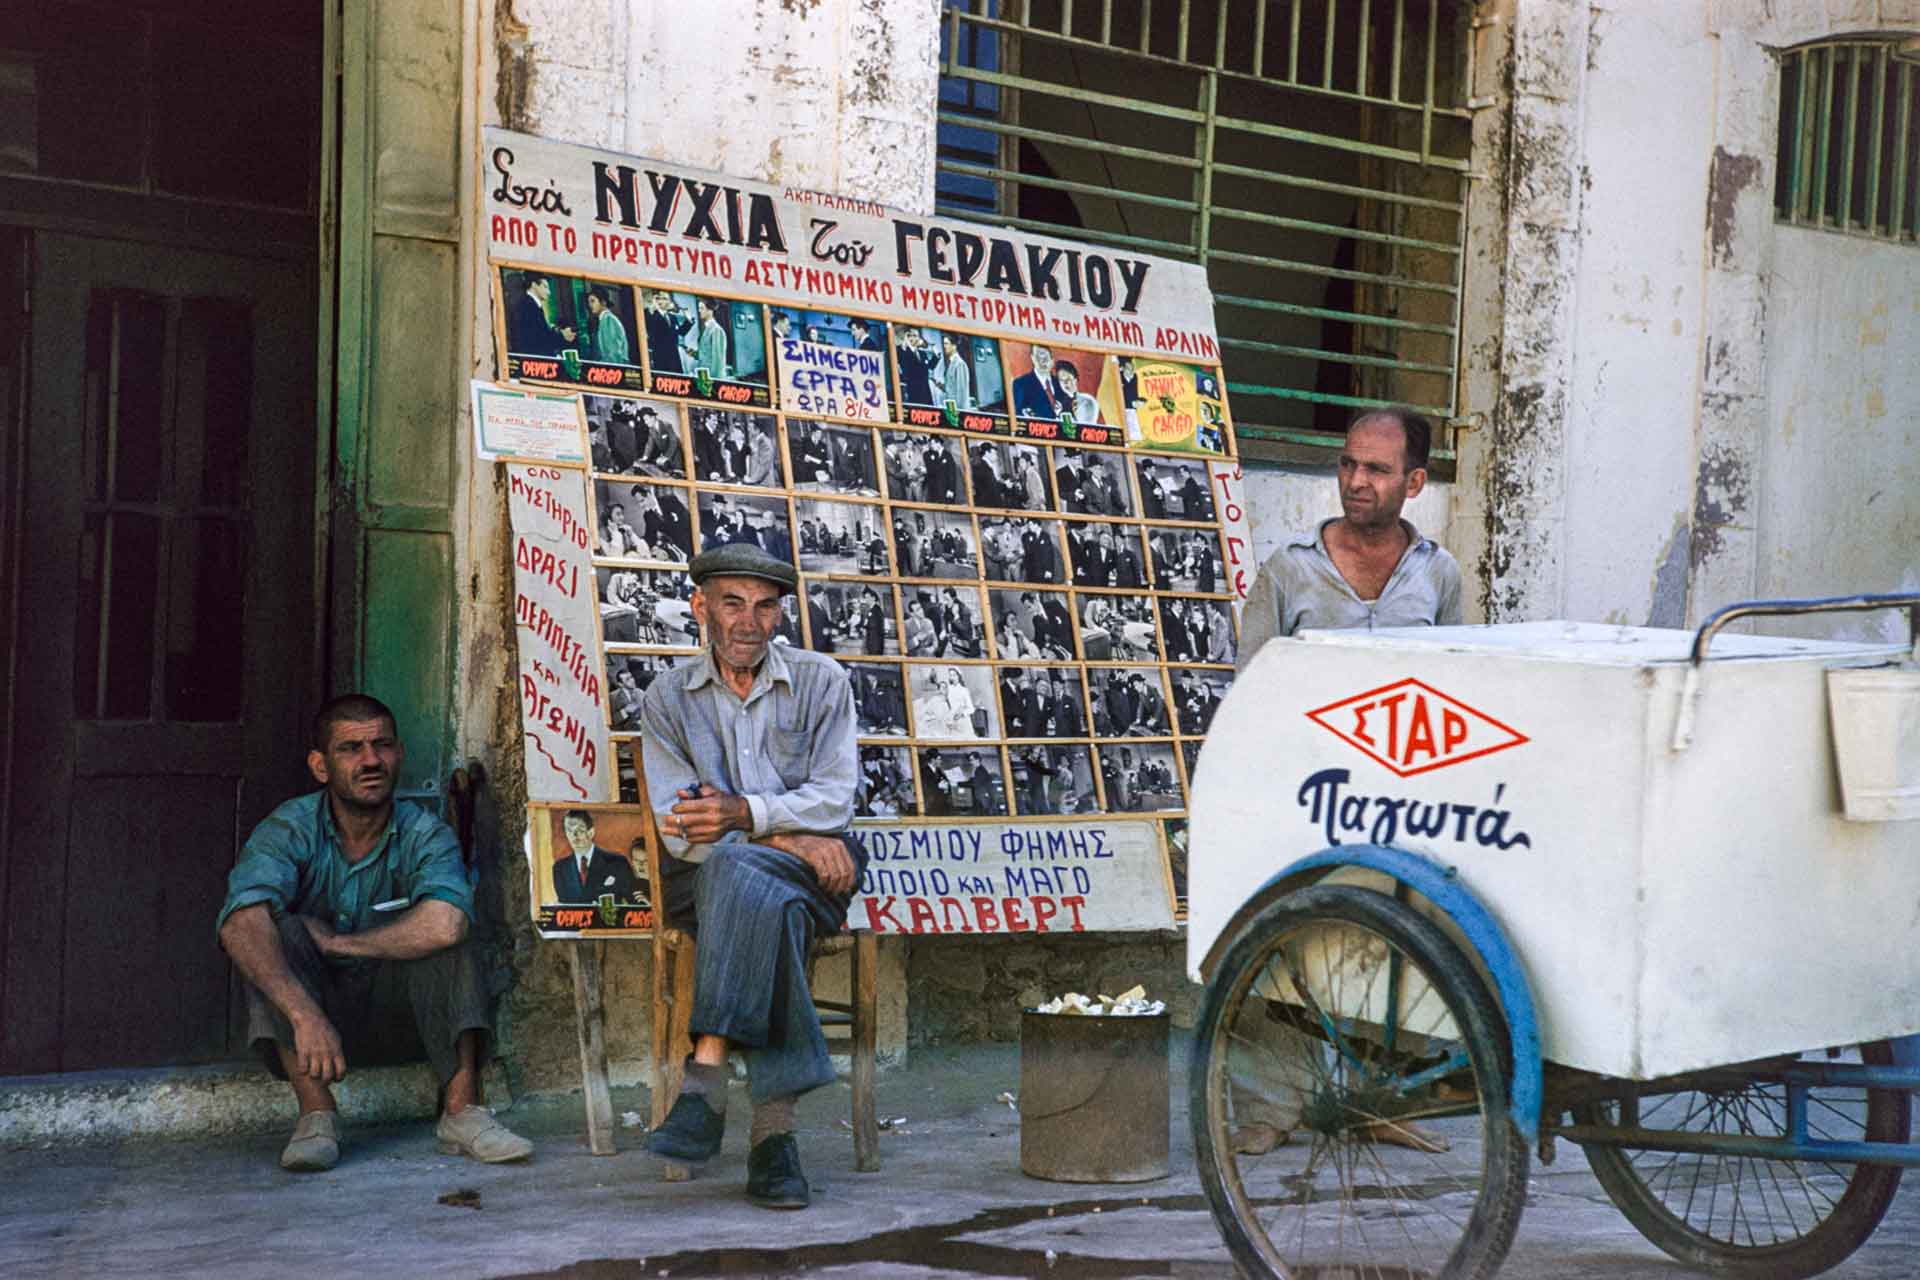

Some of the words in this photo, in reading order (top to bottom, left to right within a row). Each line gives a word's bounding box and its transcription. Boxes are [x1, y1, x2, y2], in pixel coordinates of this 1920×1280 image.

[592, 161, 788, 253] ΝΥΧΙΑ
[891, 219, 1152, 314] ΓΕΡΑΚΙΟΥ
[492, 214, 538, 247] ΑΠΟ
[545, 223, 577, 254] ΤΟ
[592, 231, 732, 279] ΠΡΩΤΟΤΥΠΟ
[744, 258, 893, 305] ΑΣΤΥΝΟΜΙΚΟ
[902, 284, 1047, 331] ΜΥΘΙΣΤΟΡΙΜΑ
[587, 368, 622, 384] CARGO
[782, 340, 880, 376] ΣΗΜΕΡΟΝ
[718, 385, 752, 402] CARGO
[792, 370, 858, 400] ΕΡΓΑ
[863, 379, 881, 408] 2
[798, 394, 838, 415] ΩΡΑ
[963, 416, 993, 433] CARGO
[1080, 428, 1108, 444] CARGO
[1152, 414, 1193, 438] CARGO
[511, 474, 588, 550] ΜΥΣΤΗΡΙΟ
[516, 537, 578, 599] ΔΡΑΣΙ
[516, 593, 601, 707] ΠΕΡΙΠΕΤΕΙΑ
[522, 674, 597, 777] ΑΓΩΝΙΑ
[1352, 692, 1469, 767] ΣΤΑΡ
[1298, 768, 1531, 850] Παγωτά
[1001, 828, 1113, 862] ΦΗΜΗΣ
[1005, 866, 1090, 896] ΜΑΓΟ
